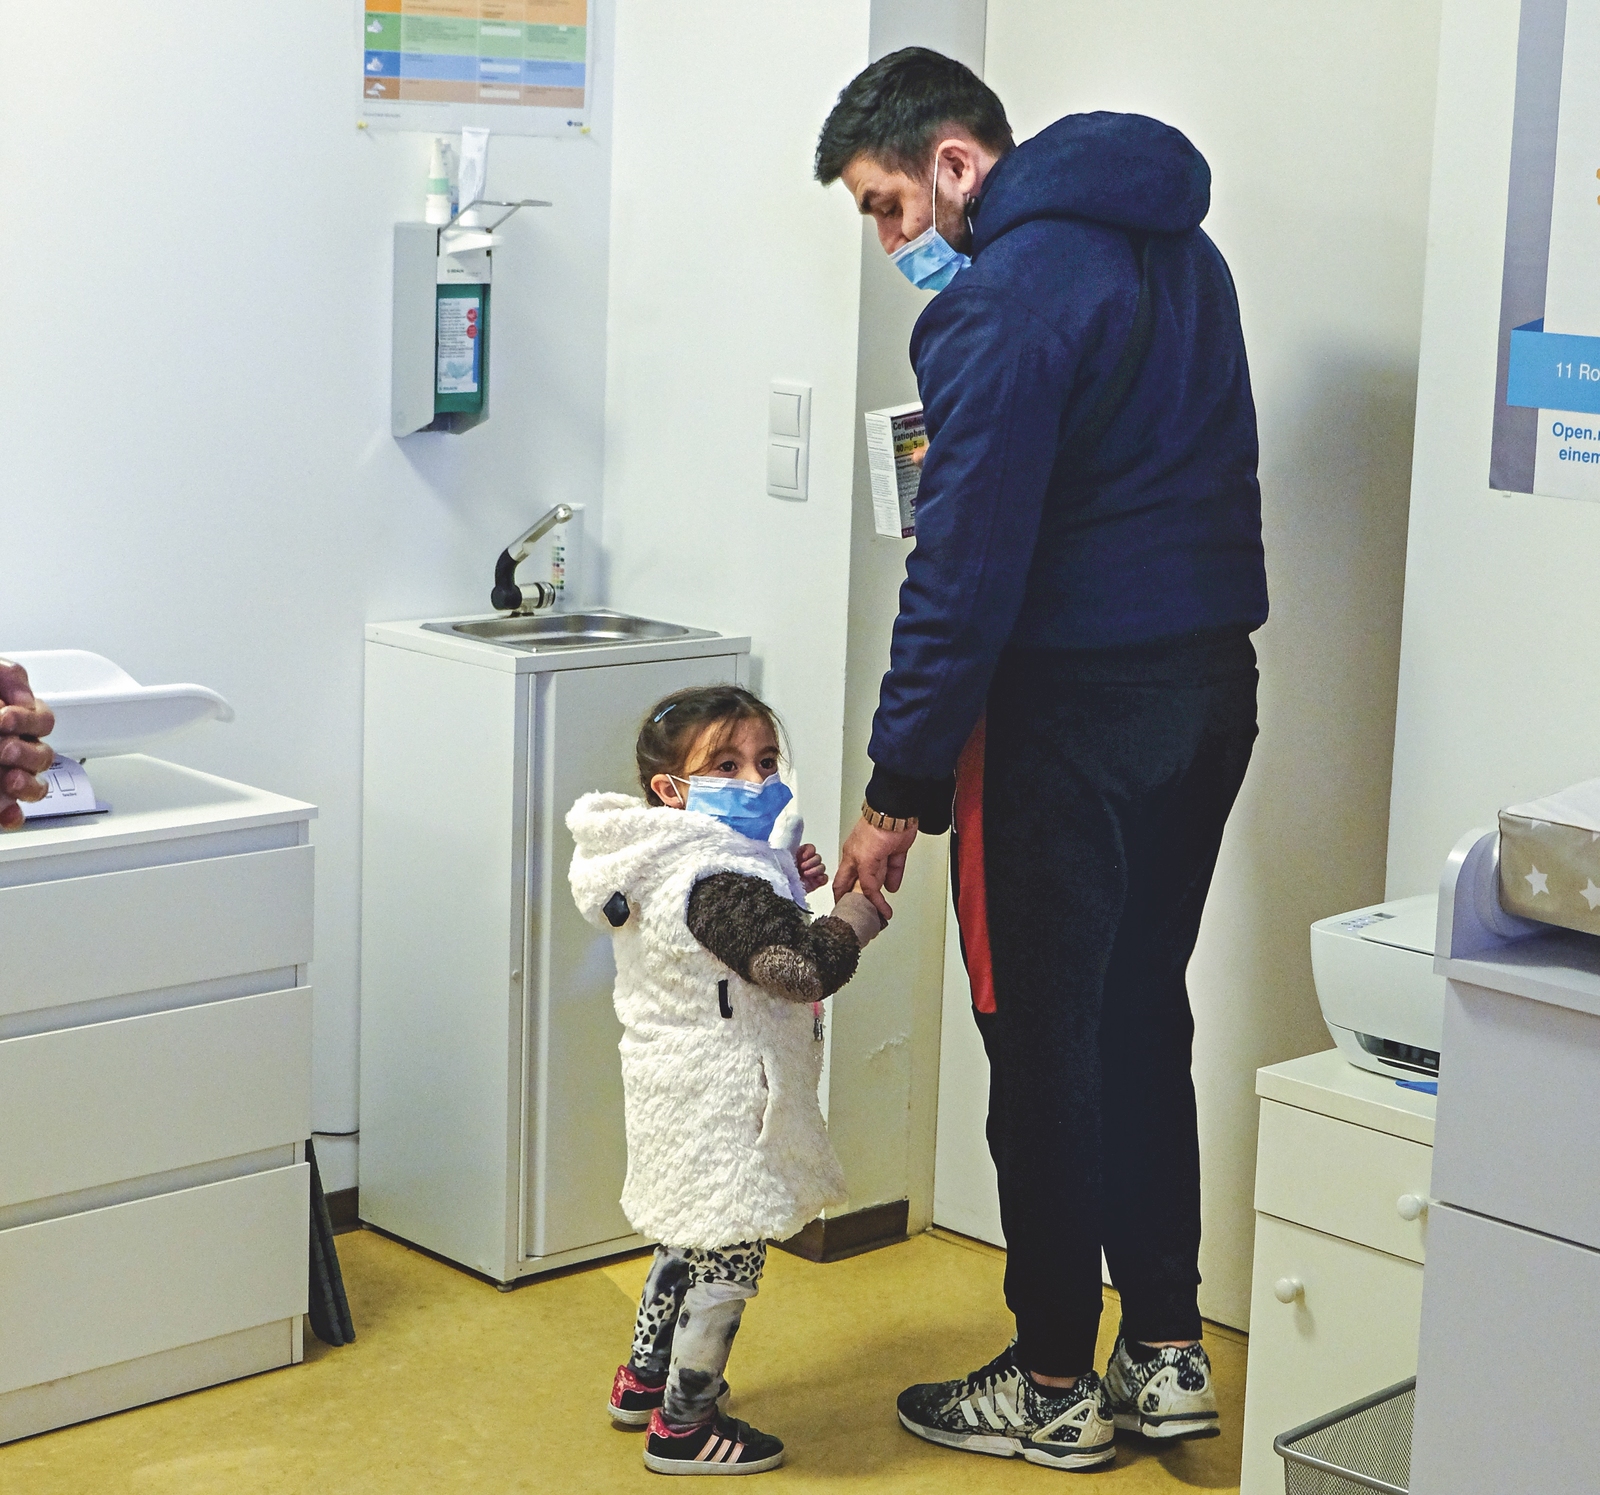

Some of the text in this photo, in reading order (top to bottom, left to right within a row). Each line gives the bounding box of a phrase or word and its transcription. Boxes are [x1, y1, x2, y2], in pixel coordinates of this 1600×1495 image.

[1556, 362, 1600, 381] 11 Ro
[1552, 422, 1600, 441] Open.
